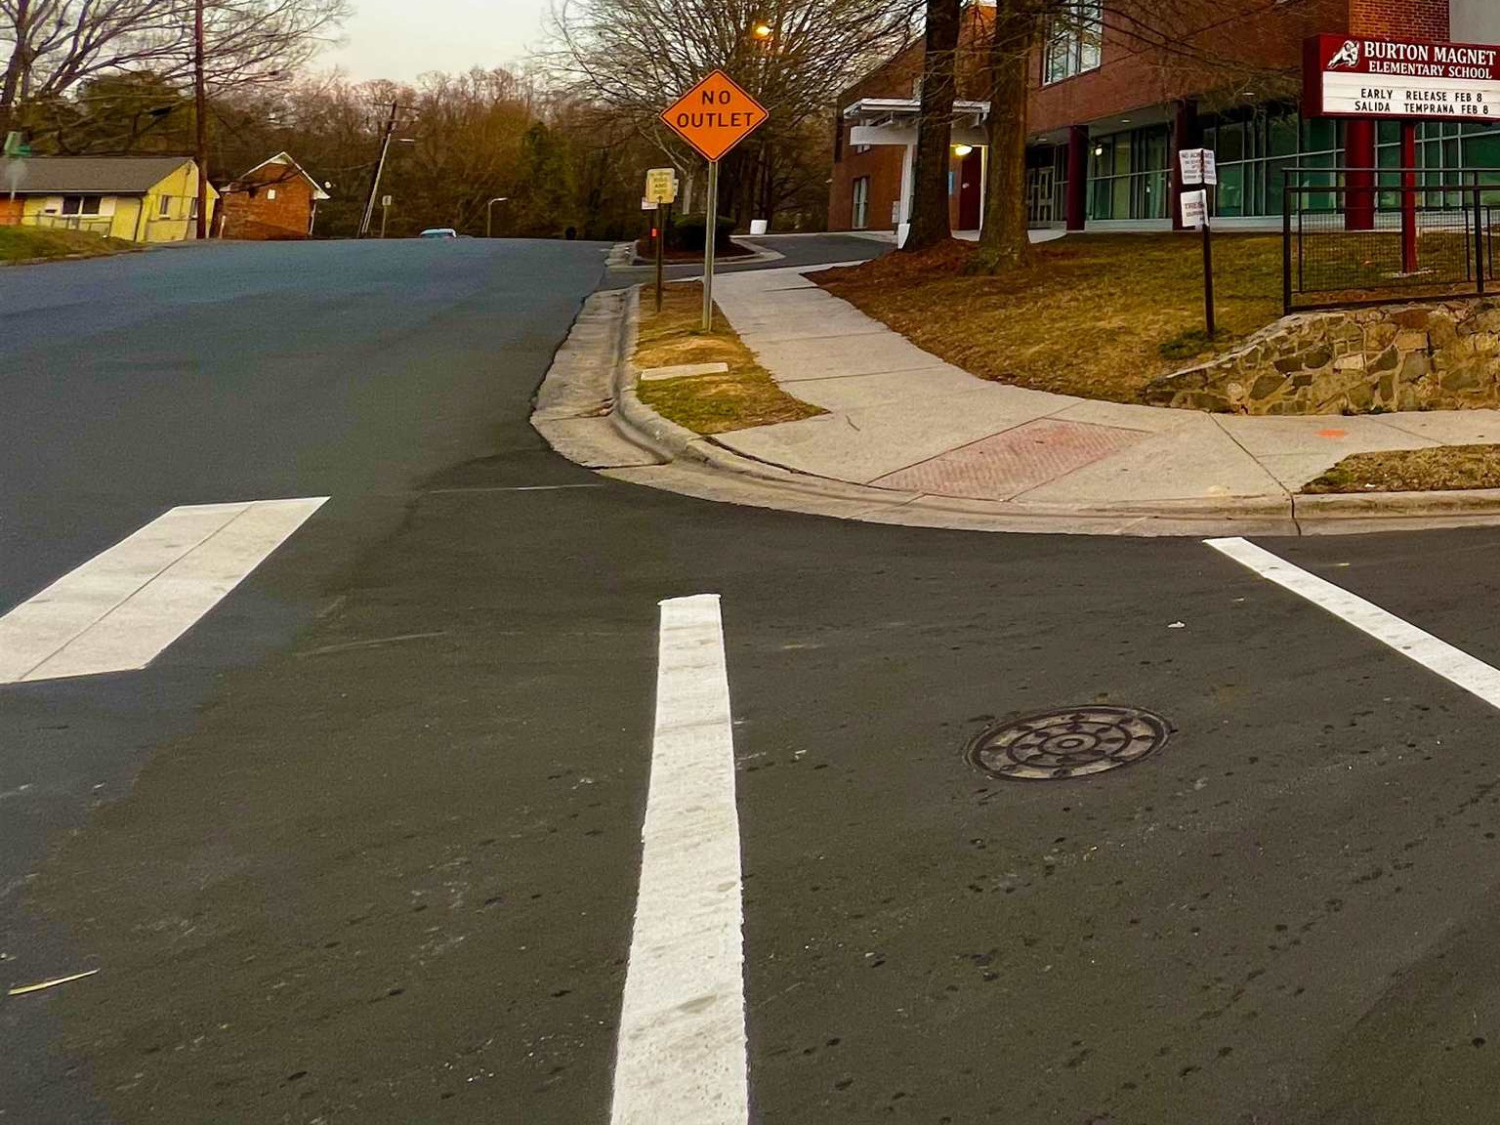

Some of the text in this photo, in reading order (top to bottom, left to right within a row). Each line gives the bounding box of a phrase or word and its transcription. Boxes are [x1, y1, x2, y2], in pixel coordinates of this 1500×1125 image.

[1364, 41, 1496, 66] BURTON MAGNET
[1368, 60, 1493, 80] ELEMENTARY SCHOOL
[702, 90, 731, 105] NO
[1361, 88, 1483, 102] EARLY RELEASE FEB 8
[1354, 100, 1489, 115] SALIDA TEMPRANA FEB 8
[676, 112, 754, 128] OUTLET
